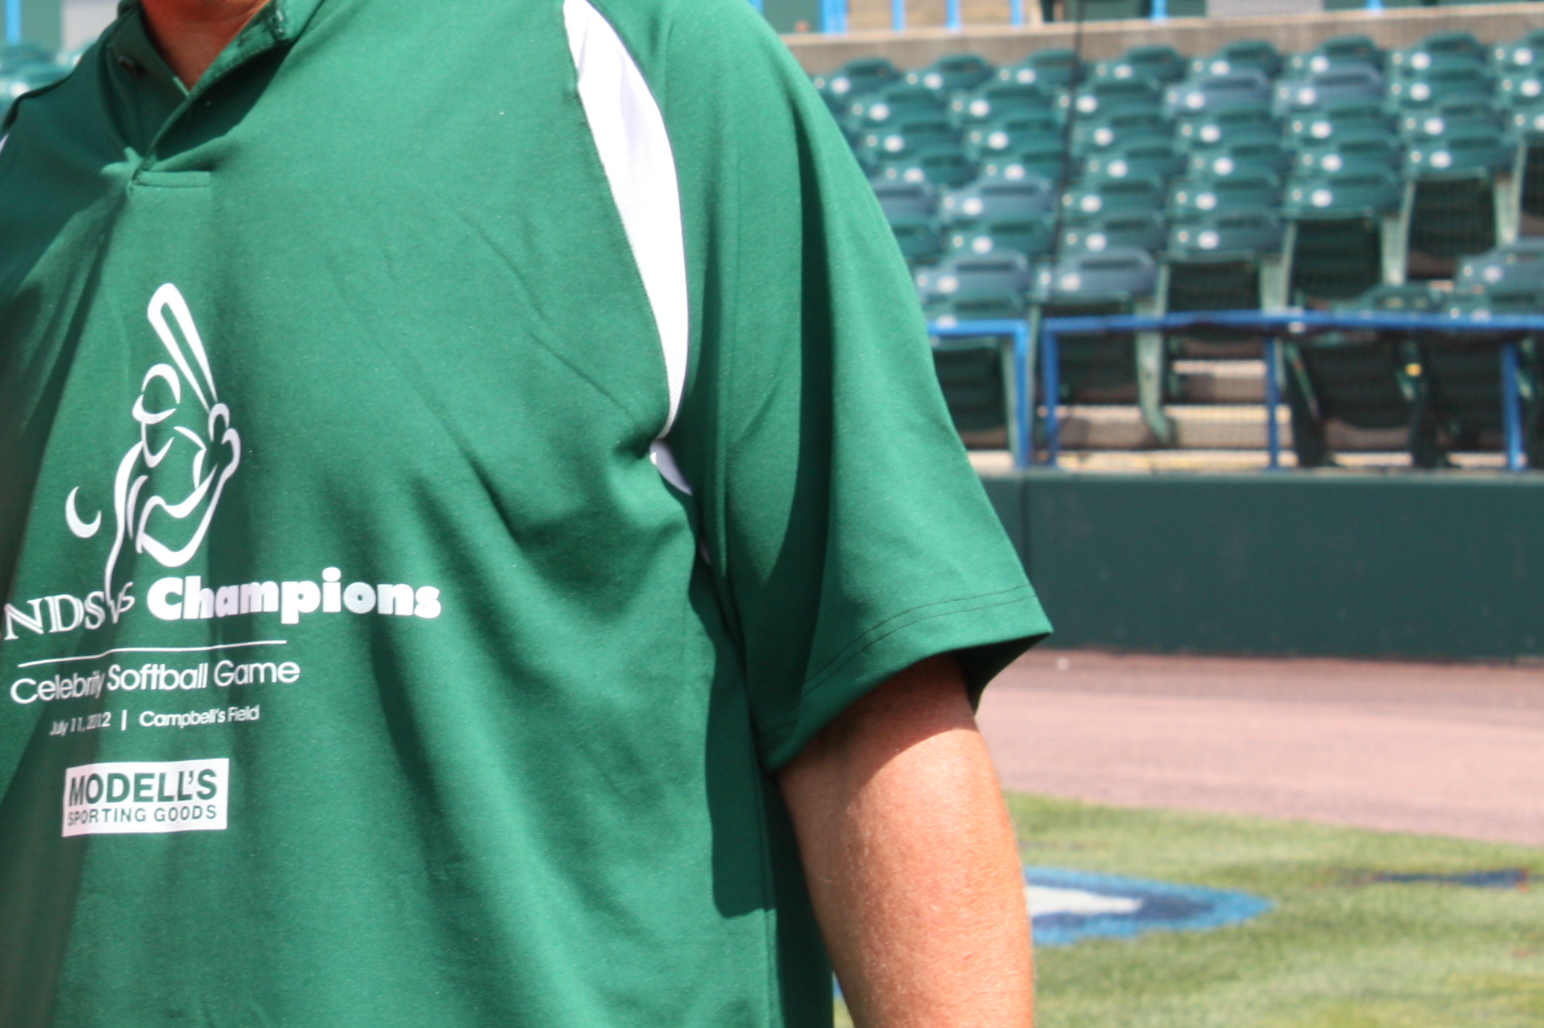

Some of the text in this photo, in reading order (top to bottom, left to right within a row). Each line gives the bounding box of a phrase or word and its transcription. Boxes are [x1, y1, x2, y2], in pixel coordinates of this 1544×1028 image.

[146, 566, 442, 625] Champions
[106, 663, 209, 691] Softball
[213, 659, 301, 688] Game
[139, 708, 226, 729] Campbell's
[227, 704, 260, 722] Field
[68, 768, 218, 807] MODELL'S
[68, 804, 217, 826] SPORTING GOODS
